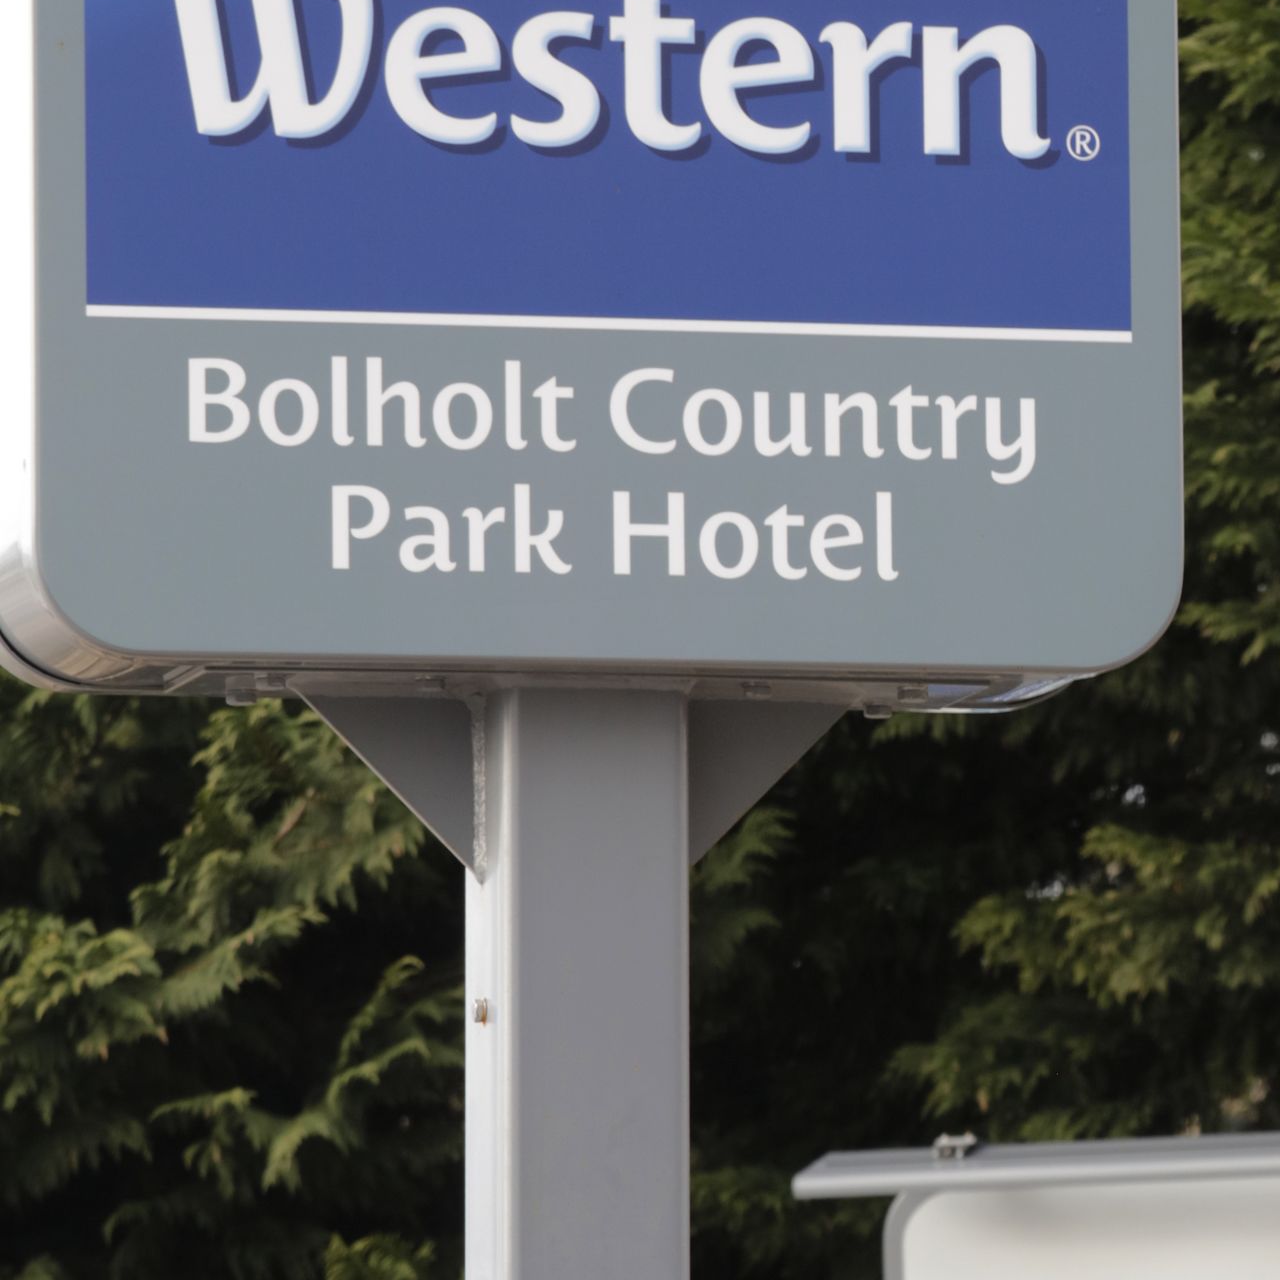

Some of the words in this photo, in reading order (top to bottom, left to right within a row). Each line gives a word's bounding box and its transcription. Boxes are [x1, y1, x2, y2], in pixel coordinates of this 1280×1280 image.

[186, 354, 578, 454] Bolholt
[608, 366, 1038, 486] Country
[330, 482, 574, 576] Park
[609, 490, 901, 582] Hotel
